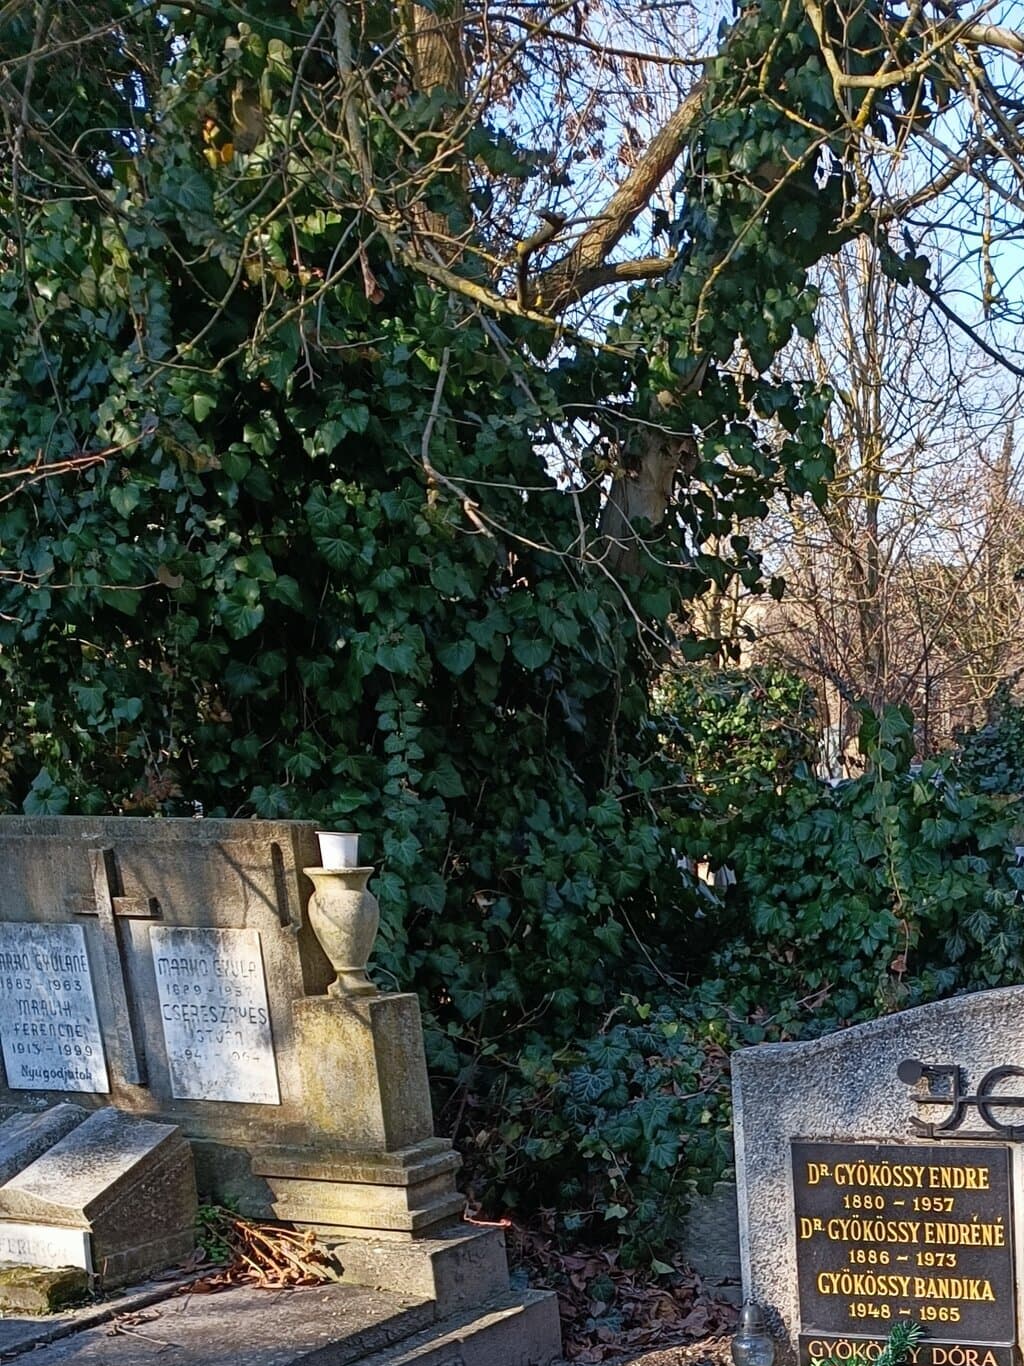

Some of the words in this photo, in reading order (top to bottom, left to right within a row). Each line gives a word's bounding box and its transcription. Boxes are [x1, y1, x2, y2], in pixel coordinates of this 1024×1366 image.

[48, 979, 82, 991] 1963
[58, 1044, 93, 1057] 1999
[21, 1064, 92, 1084] Nyugodjatok
[834, 1160, 926, 1188] GYÖKÖSSY
[929, 1166, 990, 1190] ENDRE
[843, 1194, 885, 1210] 1880
[913, 1197, 955, 1212] 1957
[827, 1214, 921, 1244] GYÖKÖSSY
[925, 1215, 1005, 1247] ENDRÉNÉ
[848, 1249, 890, 1265] 1886
[916, 1252, 957, 1267] 1973
[817, 1268, 911, 1297] GYÖKÖSSY
[914, 1276, 996, 1301] BANDIKA
[849, 1302, 891, 1319] 1948
[919, 1305, 961, 1322] 1965
[808, 1338, 922, 1364] GYÖKÖY
